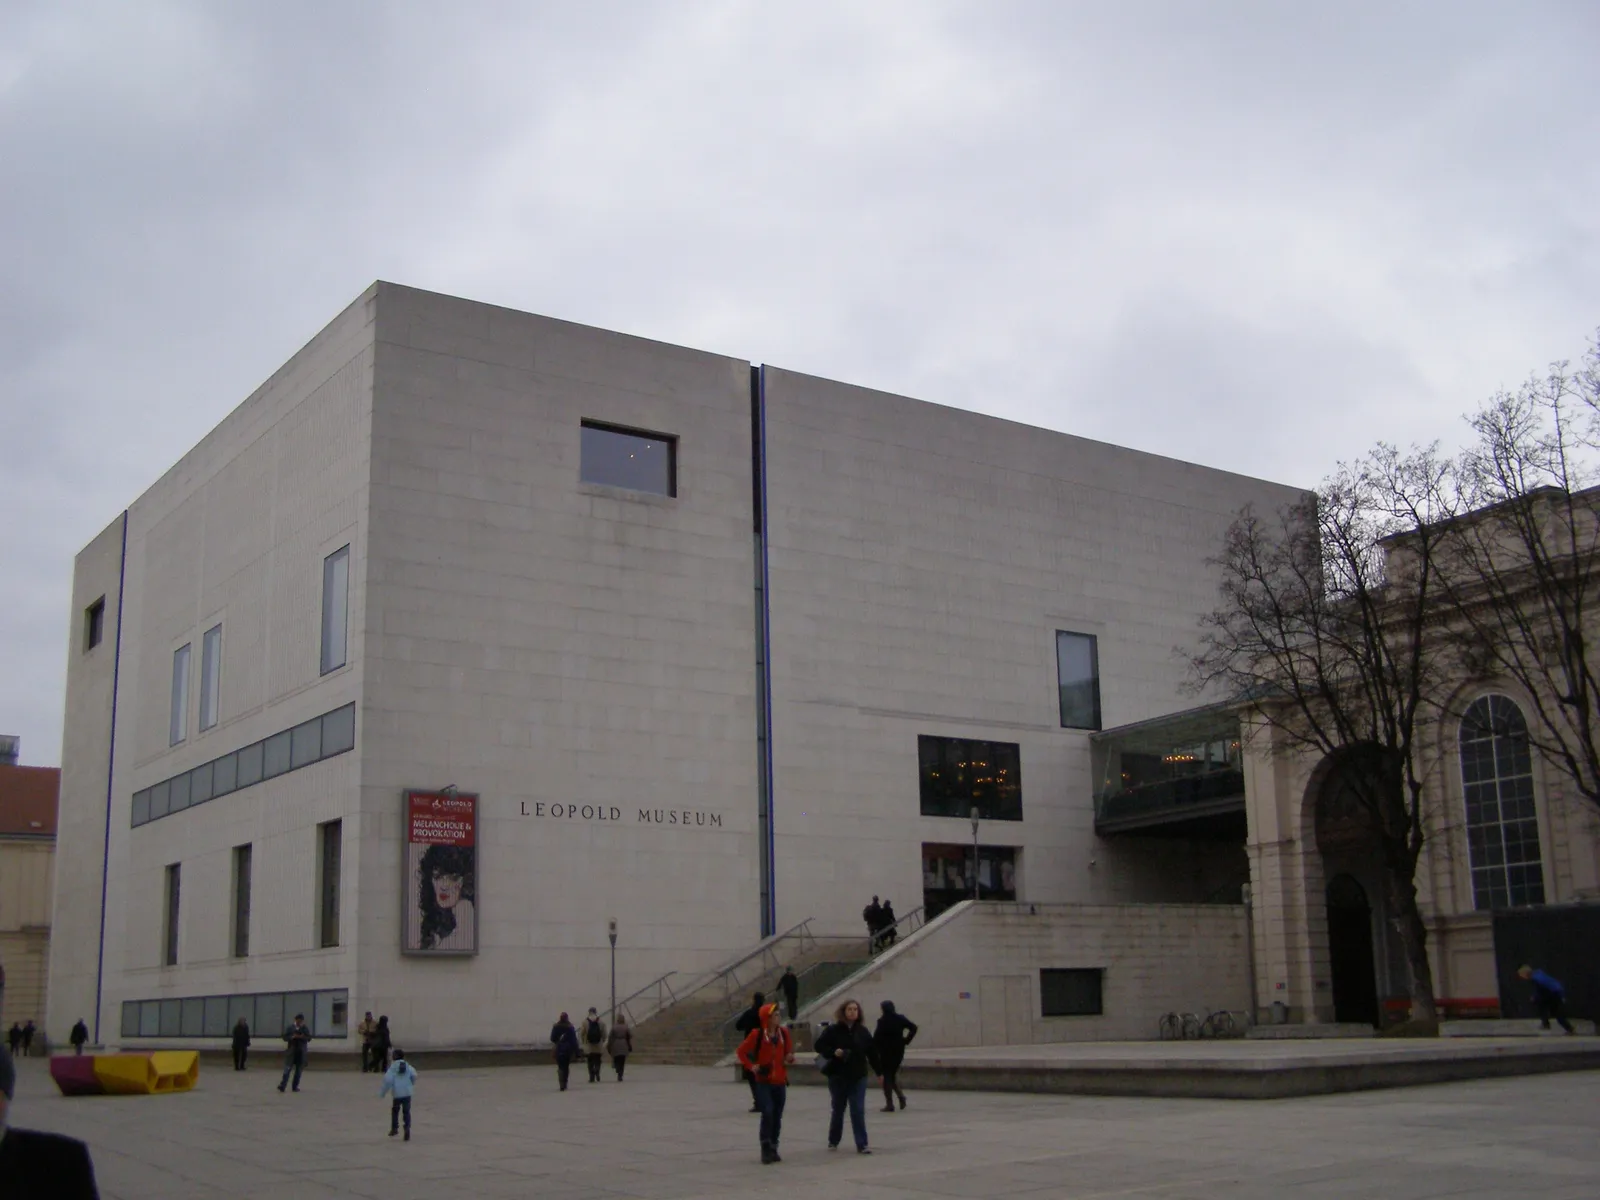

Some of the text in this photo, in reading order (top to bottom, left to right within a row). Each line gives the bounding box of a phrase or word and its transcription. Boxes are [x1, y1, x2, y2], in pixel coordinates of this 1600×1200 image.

[520, 801, 722, 827] LEOPOLD MUSEUM
[413, 828, 466, 839] PROVOKATION
